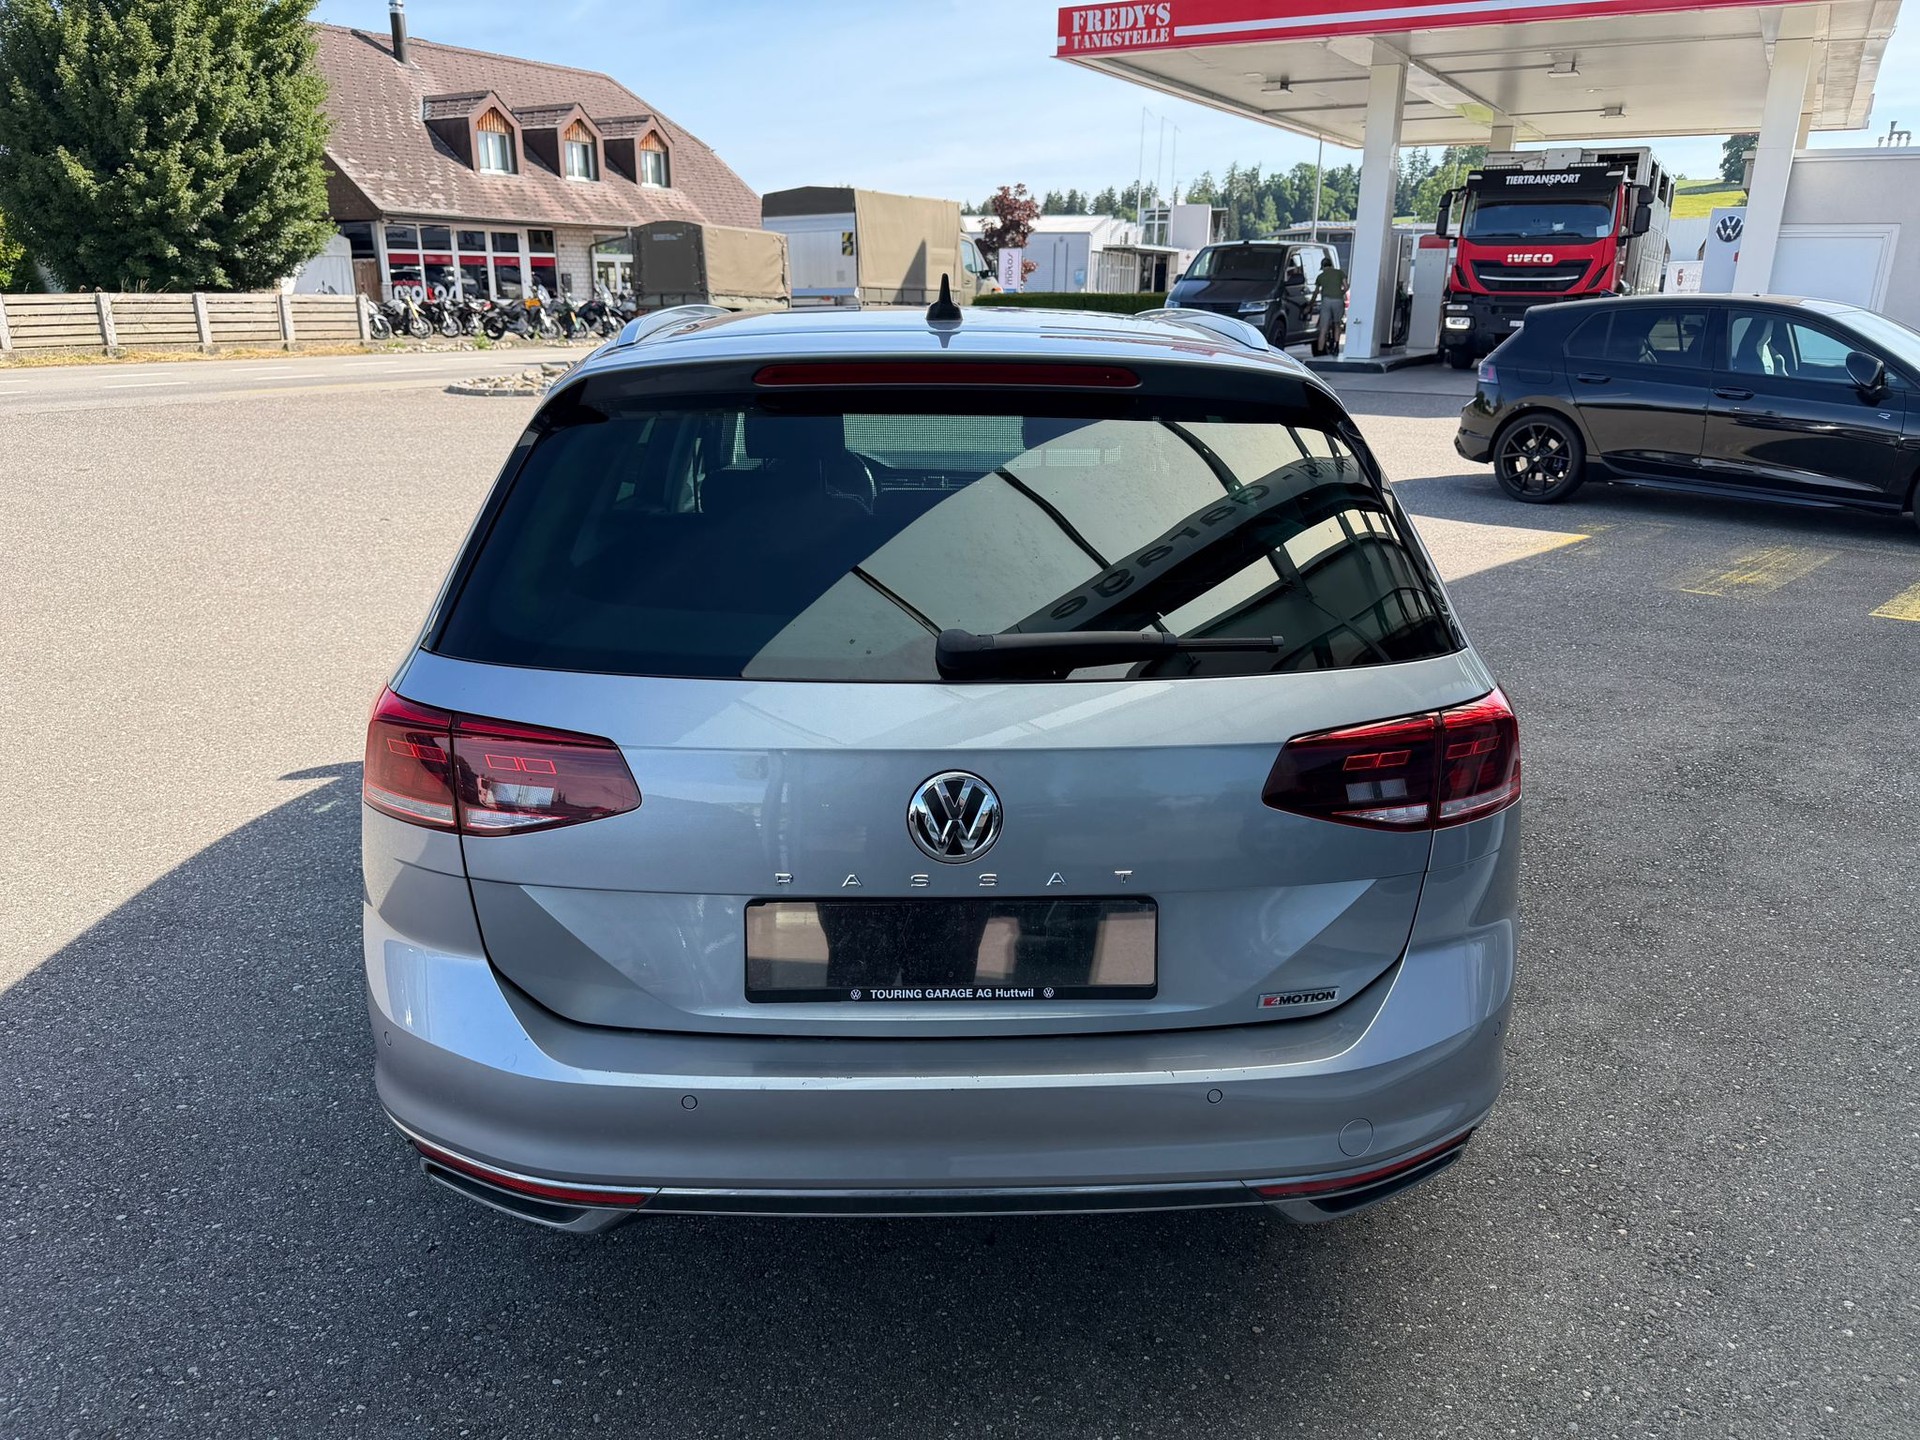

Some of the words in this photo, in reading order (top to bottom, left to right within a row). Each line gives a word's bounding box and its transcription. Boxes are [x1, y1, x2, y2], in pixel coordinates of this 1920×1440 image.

[1072, 3, 1171, 33] FREDY'S
[1072, 28, 1170, 49] TANKSTELLE
[1506, 174, 1581, 185] TIERTRANSPORT
[1507, 254, 1554, 263] IVECO
[774, 869, 1134, 888] PASSAT
[870, 989, 922, 999] TOURING
[925, 988, 973, 998] GARAGE
[976, 988, 992, 998] AG
[995, 987, 1034, 998] Huttwil
